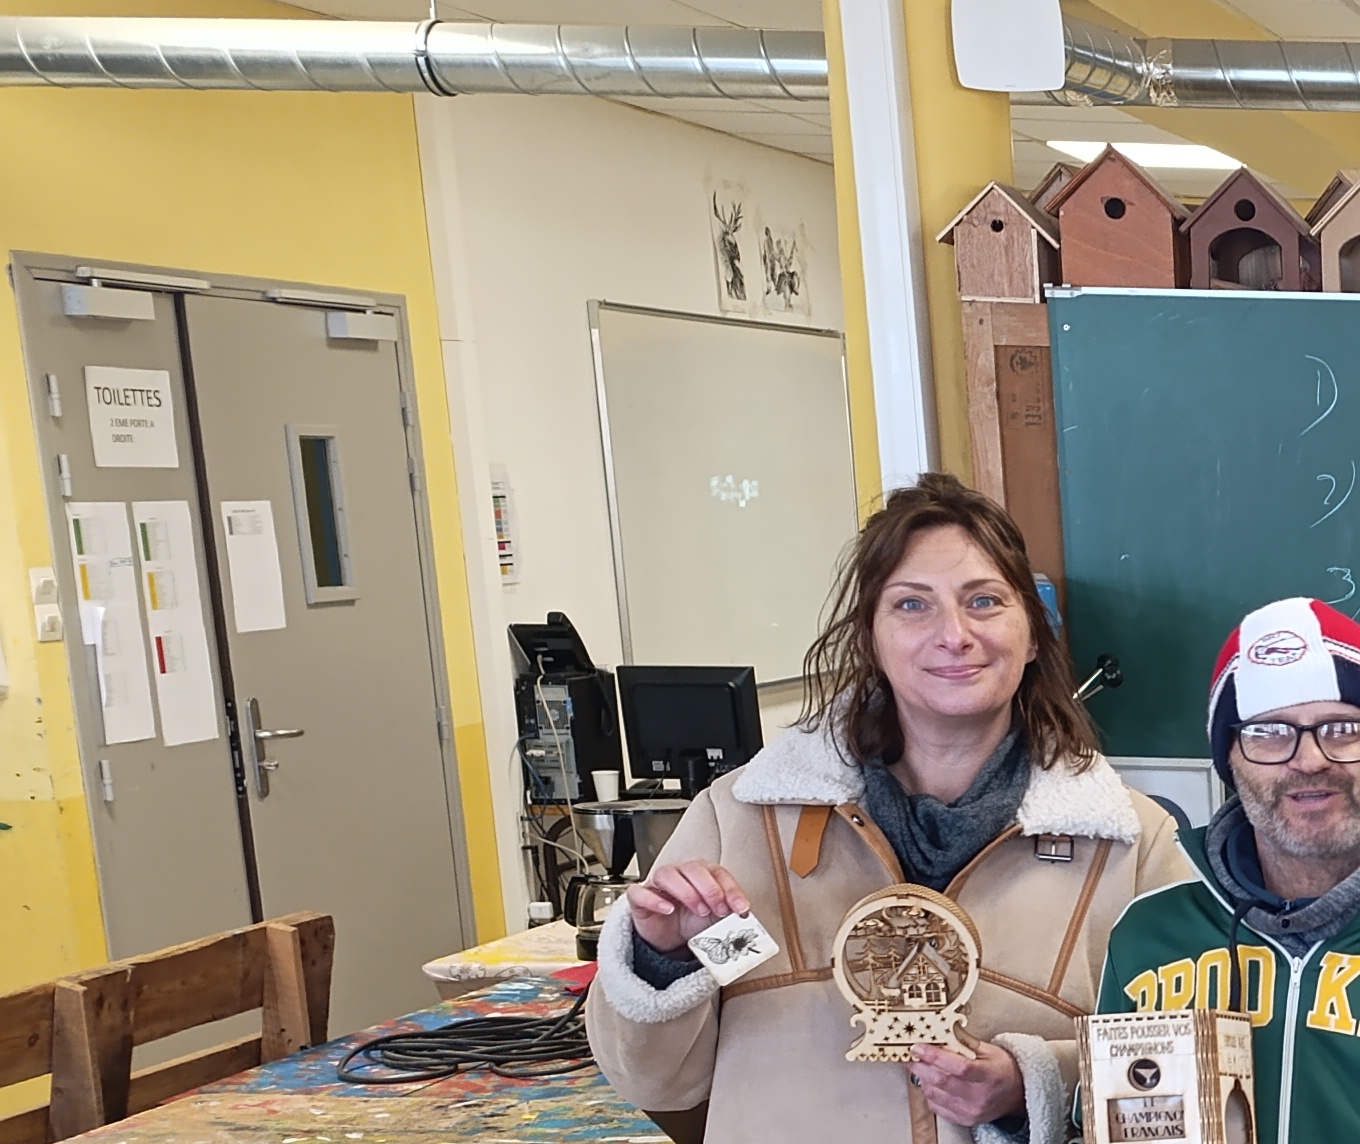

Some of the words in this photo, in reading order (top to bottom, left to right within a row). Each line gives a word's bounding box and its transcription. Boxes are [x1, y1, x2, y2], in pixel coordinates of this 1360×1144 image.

[94, 386, 162, 408] TOILETTES
[130, 418, 149, 428] PORTE
[112, 433, 134, 443] DROITE
[1097, 1025, 1129, 1041] FAITES
[1130, 1024, 1171, 1040] POUSSER
[1174, 1022, 1192, 1037] VOS
[1109, 1040, 1175, 1057] CHAMPIGNONS
